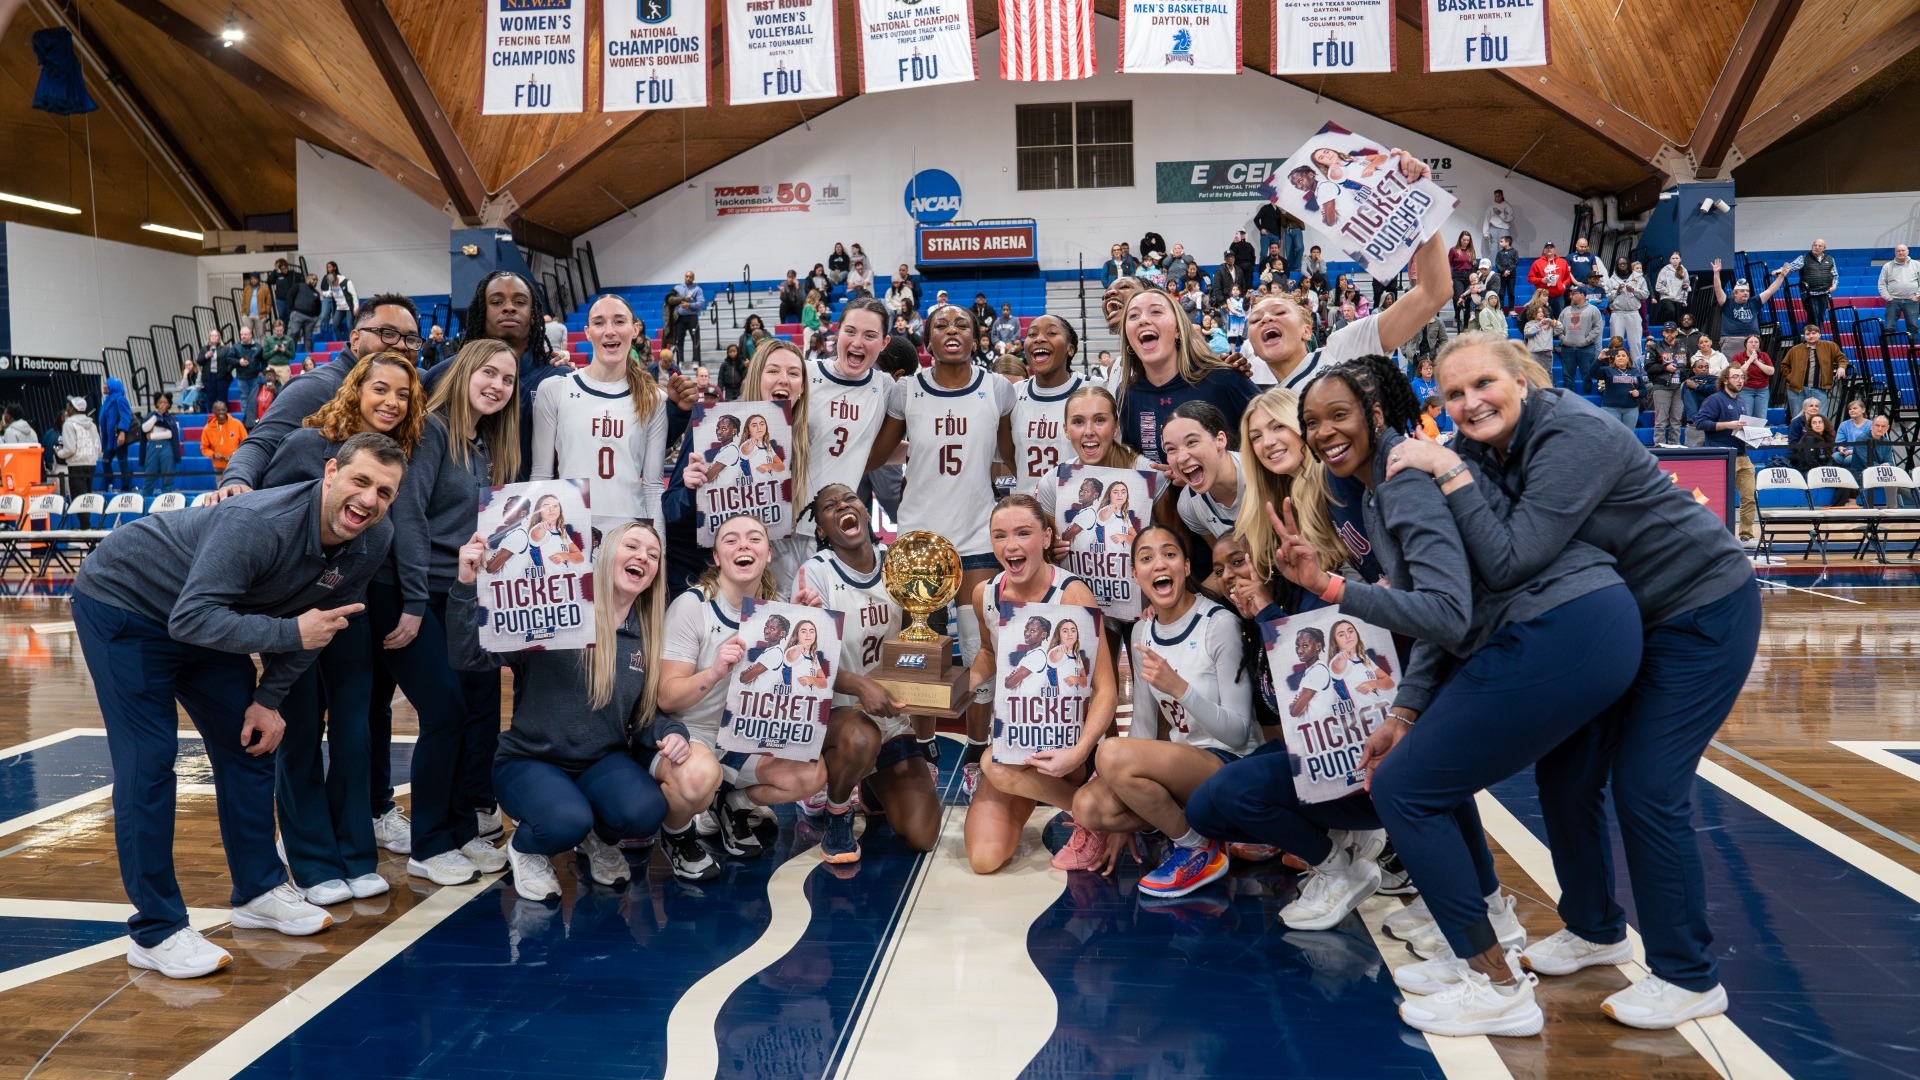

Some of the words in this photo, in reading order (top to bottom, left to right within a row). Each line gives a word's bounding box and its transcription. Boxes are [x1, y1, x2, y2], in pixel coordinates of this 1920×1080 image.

[746, 0, 775, 12] FIRST
[777, 0, 813, 10] ROUND
[887, 9, 912, 21] SALIF
[914, 6, 941, 18] MANE
[1133, 4, 1165, 13] MEN'S
[1167, 4, 1228, 14] BASKETBALL
[1437, 0, 1534, 13] BASKETBALL
[499, 15, 571, 31] WOMEN'S
[754, 11, 806, 26] WOMEN'S
[869, 18, 912, 33] NATIONAL
[913, 14, 960, 28] CHAMPION
[1151, 16, 1193, 27] DAYTON,
[1195, 16, 1210, 26] OH
[1459, 13, 1477, 21] FORT
[1478, 12, 1503, 21] WORTH,
[498, 35, 541, 46] FENCING
[544, 34, 571, 45] TEAM
[630, 26, 678, 40] NATIONAL
[748, 24, 814, 40] VOLLEYBALL
[870, 32, 889, 41] MEN'S
[889, 29, 917, 39] OUTDOOR
[918, 26, 937, 35] TRACK
[944, 24, 961, 32] FIELD
[897, 37, 917, 45] TRIPLE
[918, 34, 935, 43] JUMP
[608, 36, 700, 57] CHAMPIONS
[748, 39, 767, 50] NCAA
[768, 37, 814, 48] TOURNAMENT
[1465, 36, 1508, 63] FDU
[492, 48, 576, 67] CHAMPIONS
[609, 55, 655, 68] WOMEN'S
[656, 53, 700, 66] BOWLING
[1312, 41, 1354, 67] FDU
[898, 54, 939, 82] FDU
[635, 78, 674, 104] FDU
[763, 69, 802, 96] FDU
[514, 83, 551, 108] FDU
[714, 185, 760, 197] TOYOTA
[776, 182, 812, 204] 50
[822, 186, 839, 198] FDU
[1354, 185, 1372, 204] FDU
[715, 197, 774, 207] Hackensack
[911, 195, 961, 213] NCAA
[1341, 169, 1407, 244] TICKET
[1366, 190, 1431, 261] PUNCHED
[927, 236, 980, 252] STRATIS
[983, 235, 1027, 250] ARENA
[22, 357, 68, 371] Restroom
[830, 400, 860, 421] FDU
[592, 417, 624, 439] FDU
[934, 416, 967, 436] FDU
[1027, 421, 1059, 439] FDU
[828, 426, 849, 458] 3
[598, 446, 615, 480] 0
[938, 444, 963, 477] 15
[1027, 445, 1059, 478] 23
[1771, 468, 1788, 478] FDU
[1821, 467, 1838, 478] FDU
[1876, 466, 1893, 477] FDU
[706, 479, 779, 513] TICKET
[1089, 543, 1105, 553] FDU
[525, 566, 544, 579] FDU
[1068, 550, 1130, 579] TICKET
[489, 572, 577, 609] TICKET
[494, 603, 581, 634] PUNCHED
[860, 603, 889, 628] FDU
[773, 684, 791, 695] FDU
[1040, 686, 1058, 698] FDU
[740, 690, 818, 722] TICKET
[1007, 696, 1083, 724] TICKET
[1332, 701, 1353, 716] FDU
[734, 717, 814, 743] PUNCHED
[1008, 725, 1081, 747] PUNCHED
[1297, 701, 1391, 754] TICKET
